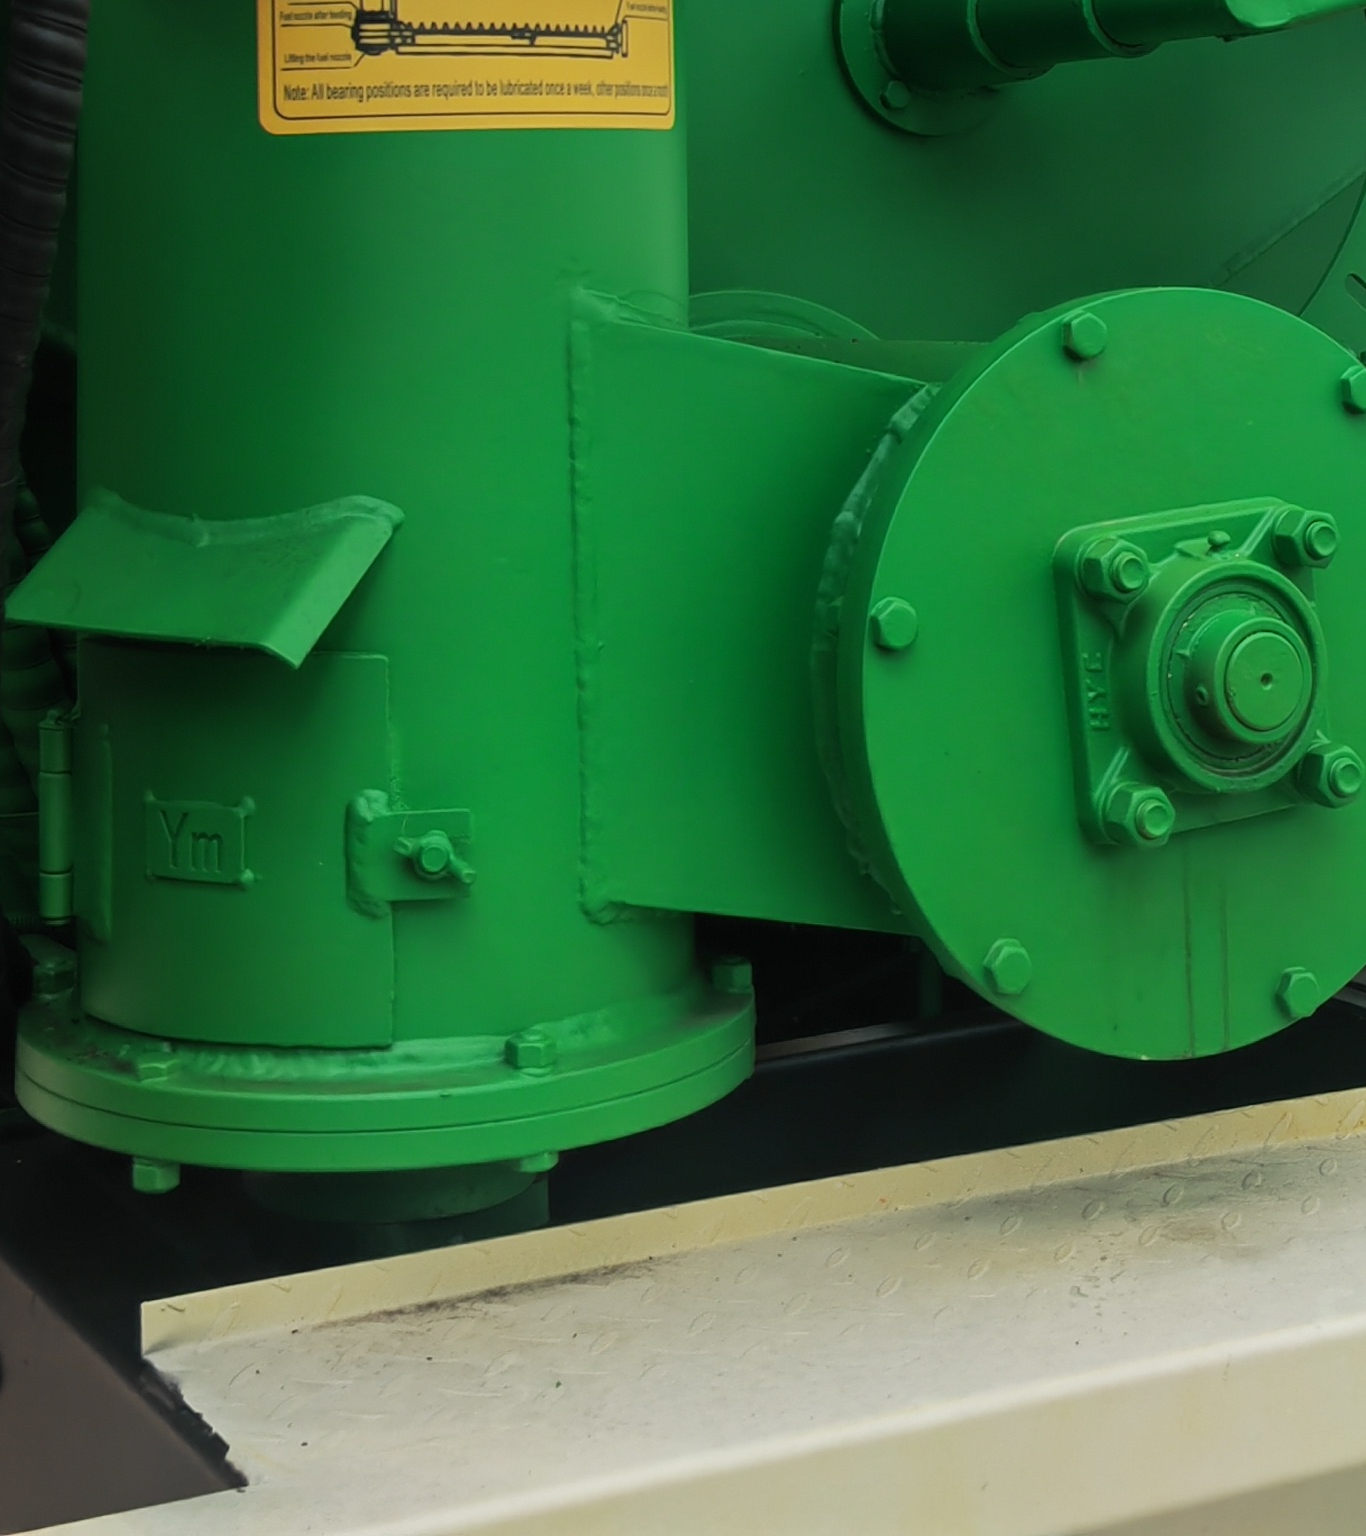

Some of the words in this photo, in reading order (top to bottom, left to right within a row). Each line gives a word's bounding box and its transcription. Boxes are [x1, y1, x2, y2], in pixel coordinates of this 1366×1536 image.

[284, 84, 310, 100] Note:
[311, 82, 324, 99] All
[327, 82, 364, 103] bearing
[366, 81, 411, 102] positions
[414, 84, 430, 97] are
[432, 80, 472, 100] required
[475, 80, 484, 96] to
[486, 80, 497, 96] be
[500, 79, 543, 96] lubricated
[546, 82, 565, 96] once
[159, 810, 223, 874] Ym
